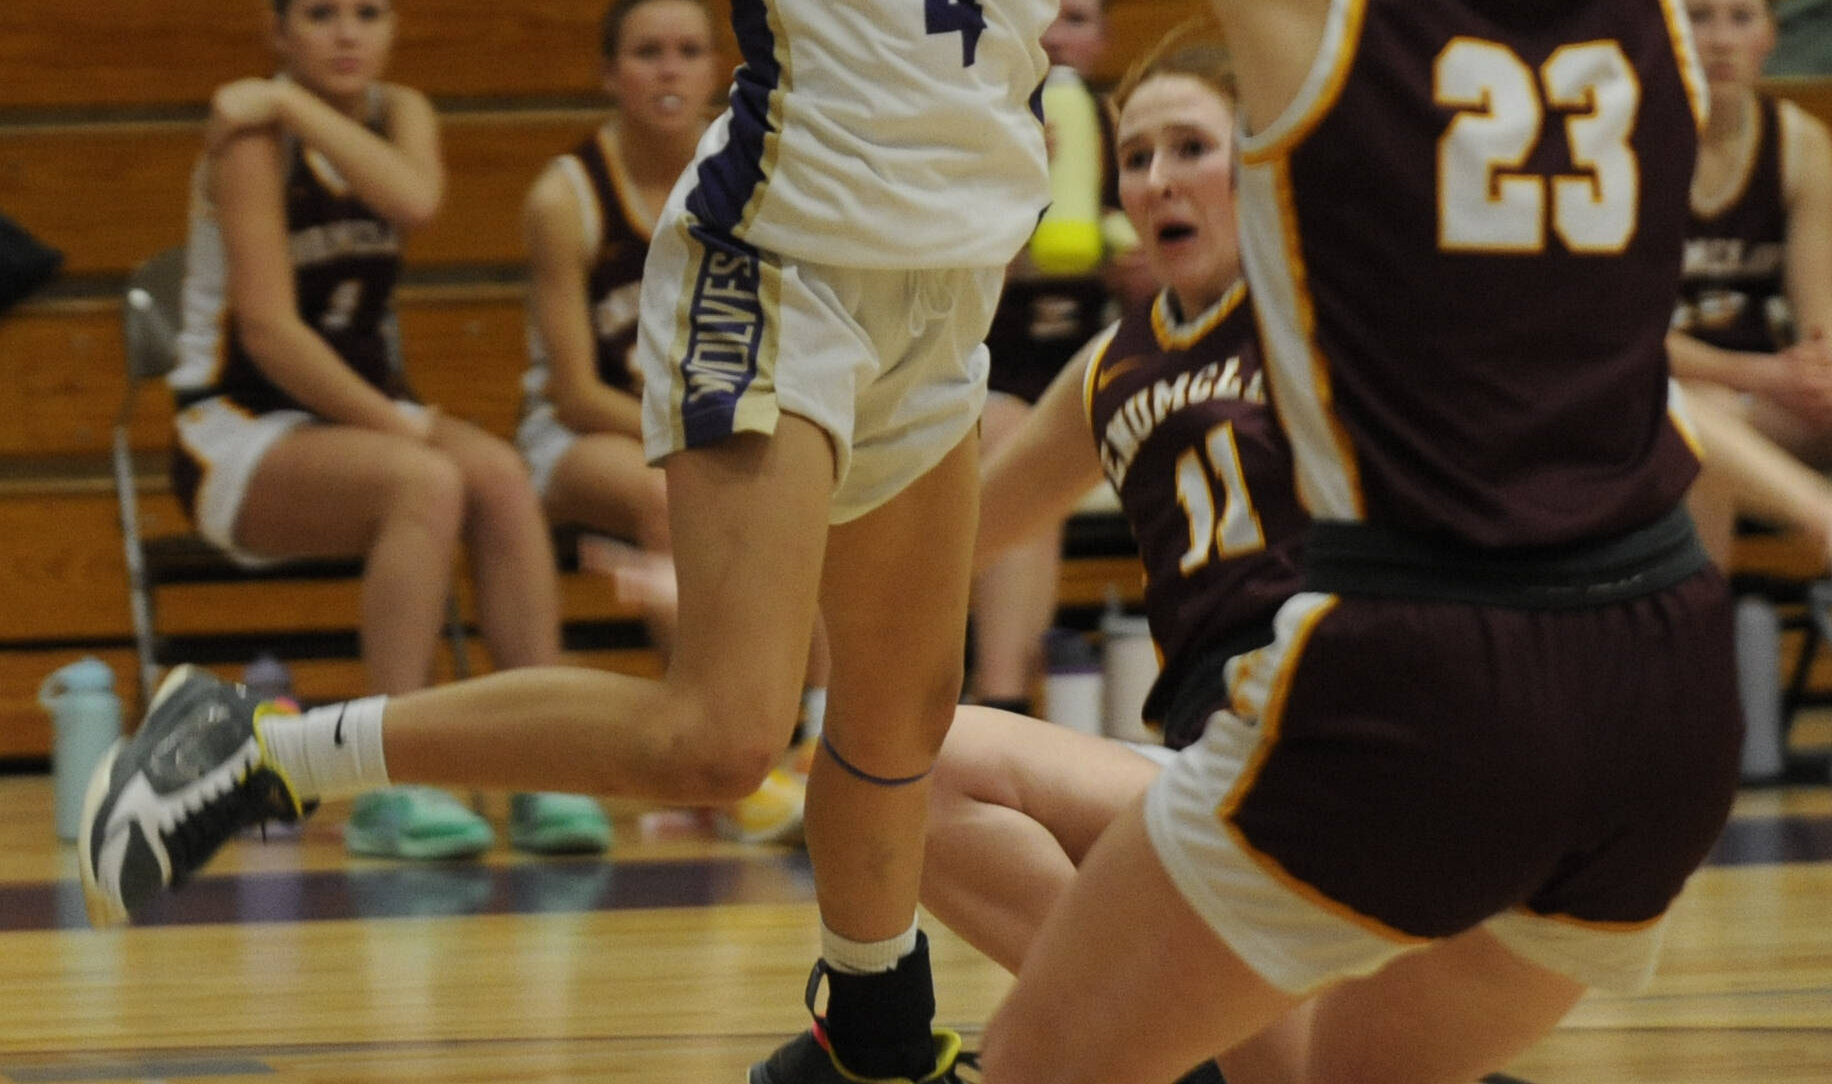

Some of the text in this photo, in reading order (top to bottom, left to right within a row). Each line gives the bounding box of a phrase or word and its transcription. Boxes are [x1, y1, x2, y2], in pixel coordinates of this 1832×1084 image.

[1432, 35, 1643, 255] 23
[684, 251, 757, 404] WOLVES
[1173, 419, 1267, 577] 11
